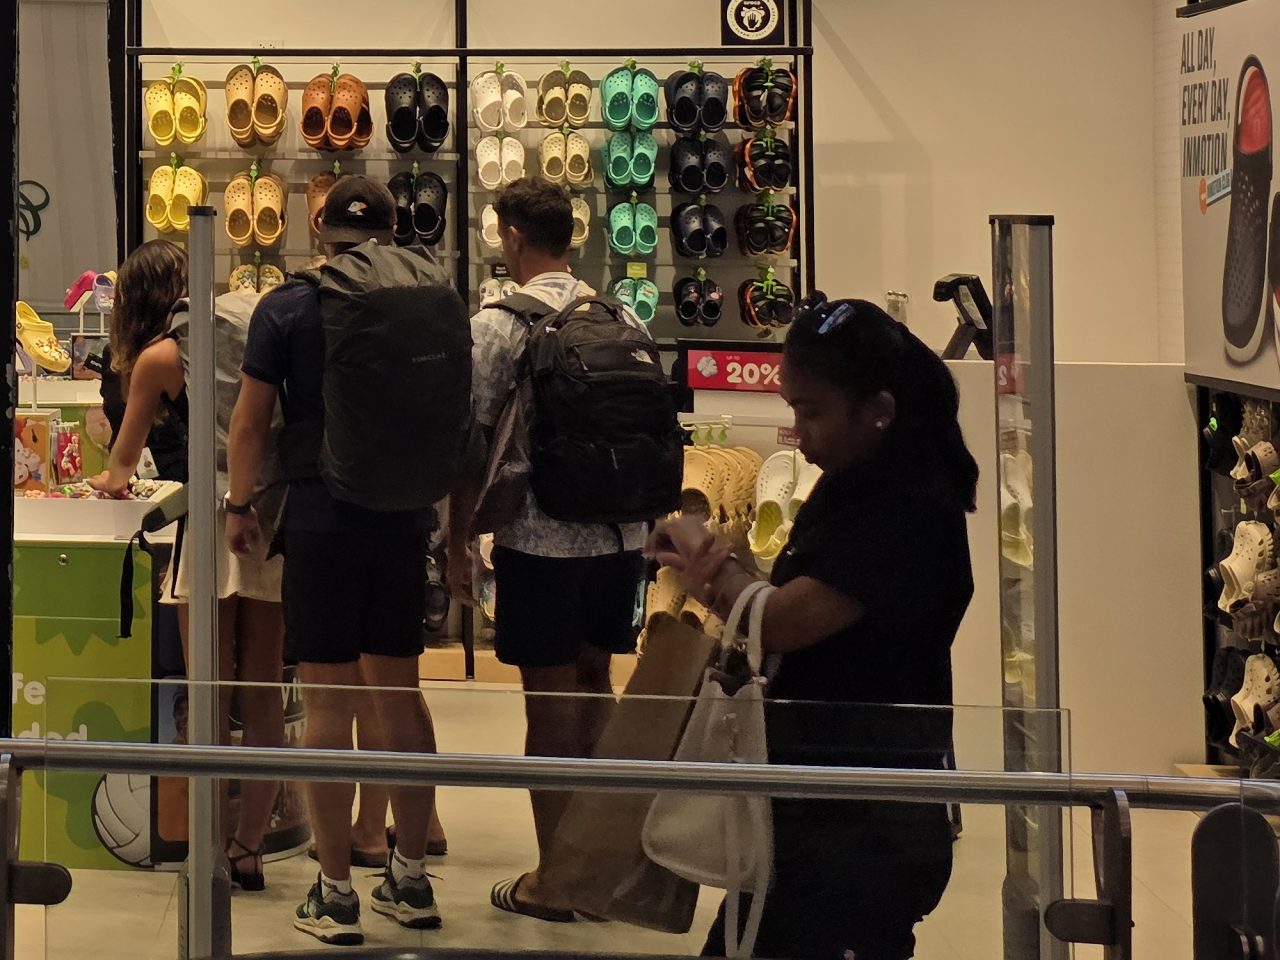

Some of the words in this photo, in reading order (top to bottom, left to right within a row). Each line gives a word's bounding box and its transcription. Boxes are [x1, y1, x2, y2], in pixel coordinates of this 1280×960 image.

[1180, 32, 1195, 75] ALL
[1197, 26, 1217, 77] DAY,
[1181, 81, 1209, 126] EVERY
[1210, 77, 1231, 129] DAY,
[726, 361, 782, 386] 20%
